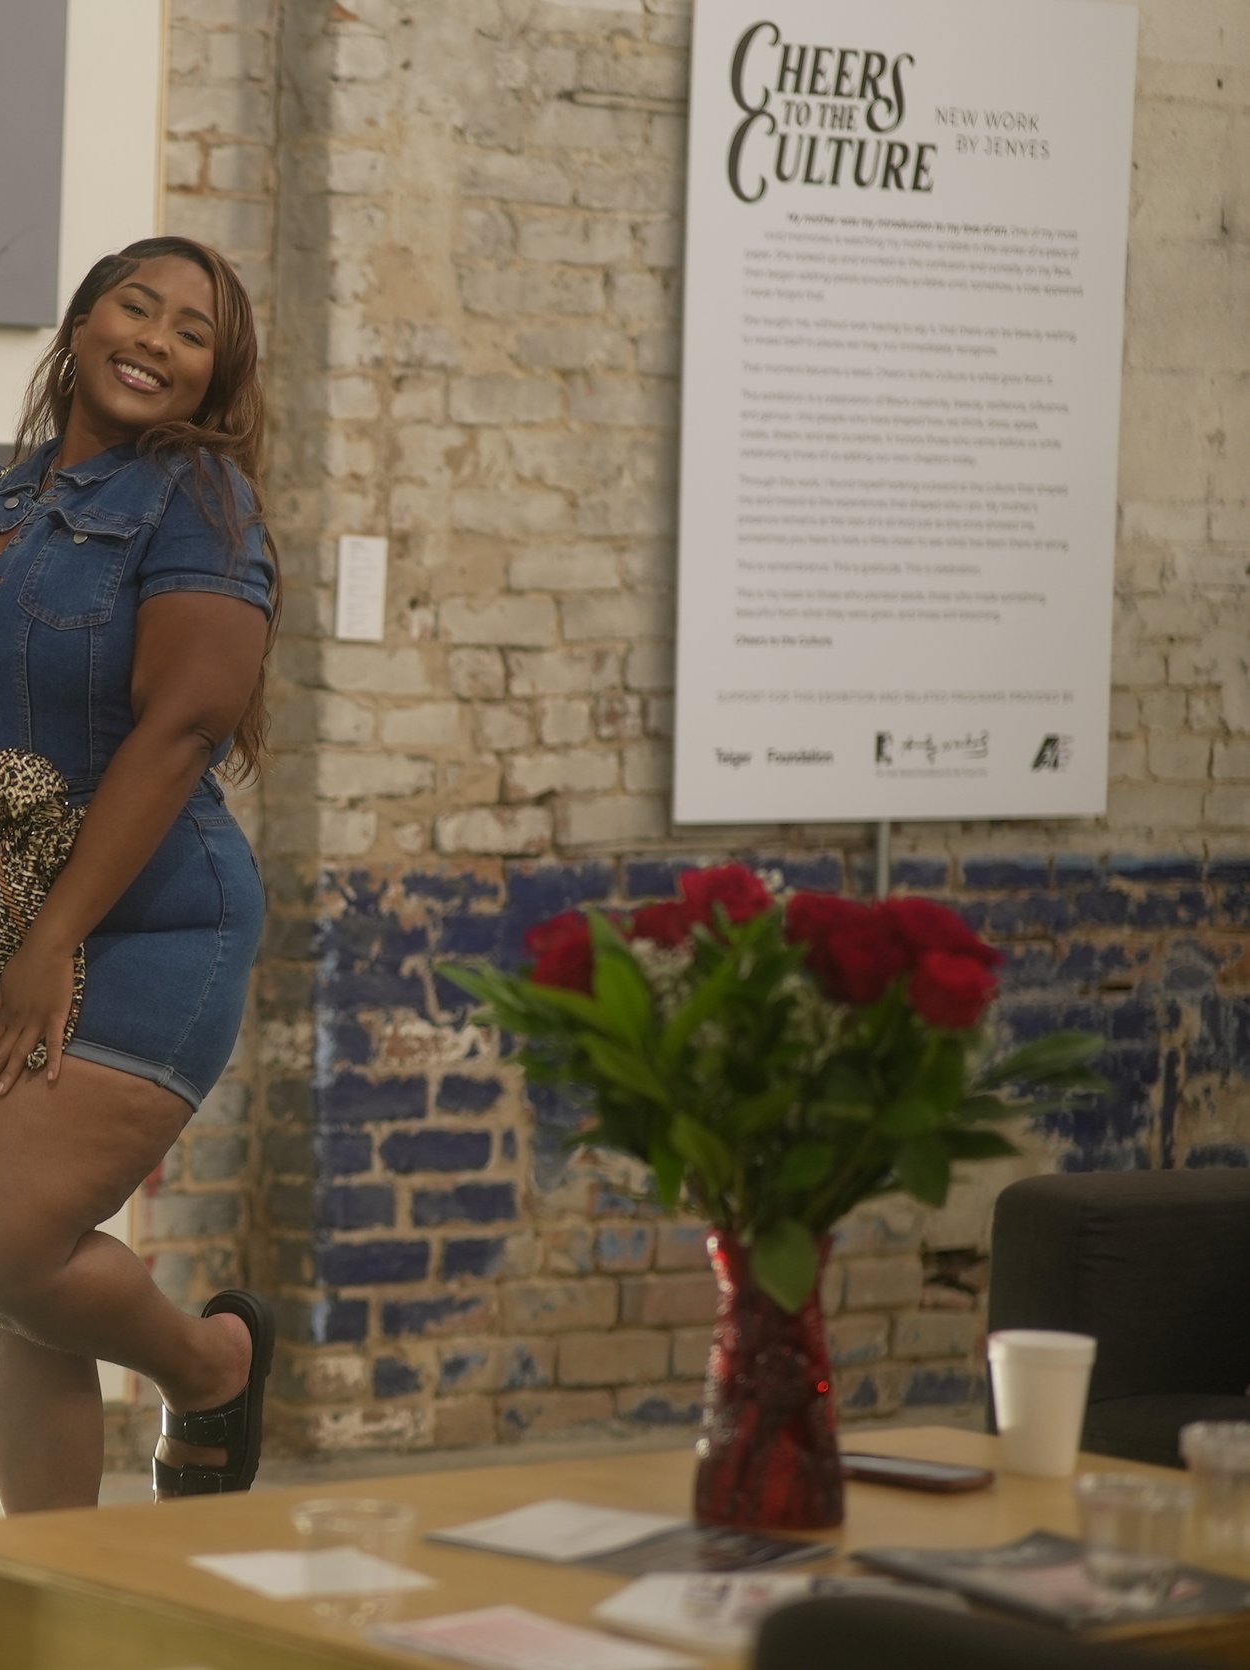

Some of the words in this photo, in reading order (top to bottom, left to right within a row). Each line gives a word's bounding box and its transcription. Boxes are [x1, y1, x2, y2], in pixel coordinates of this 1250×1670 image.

[731, 20, 915, 132] CHEERS
[782, 99, 810, 128] TO
[816, 102, 858, 132] THE
[934, 105, 979, 128] NEW
[985, 109, 1041, 133] WORK
[728, 110, 938, 205] CULTURE
[955, 132, 979, 155] BY
[983, 135, 1051, 160] JENYES
